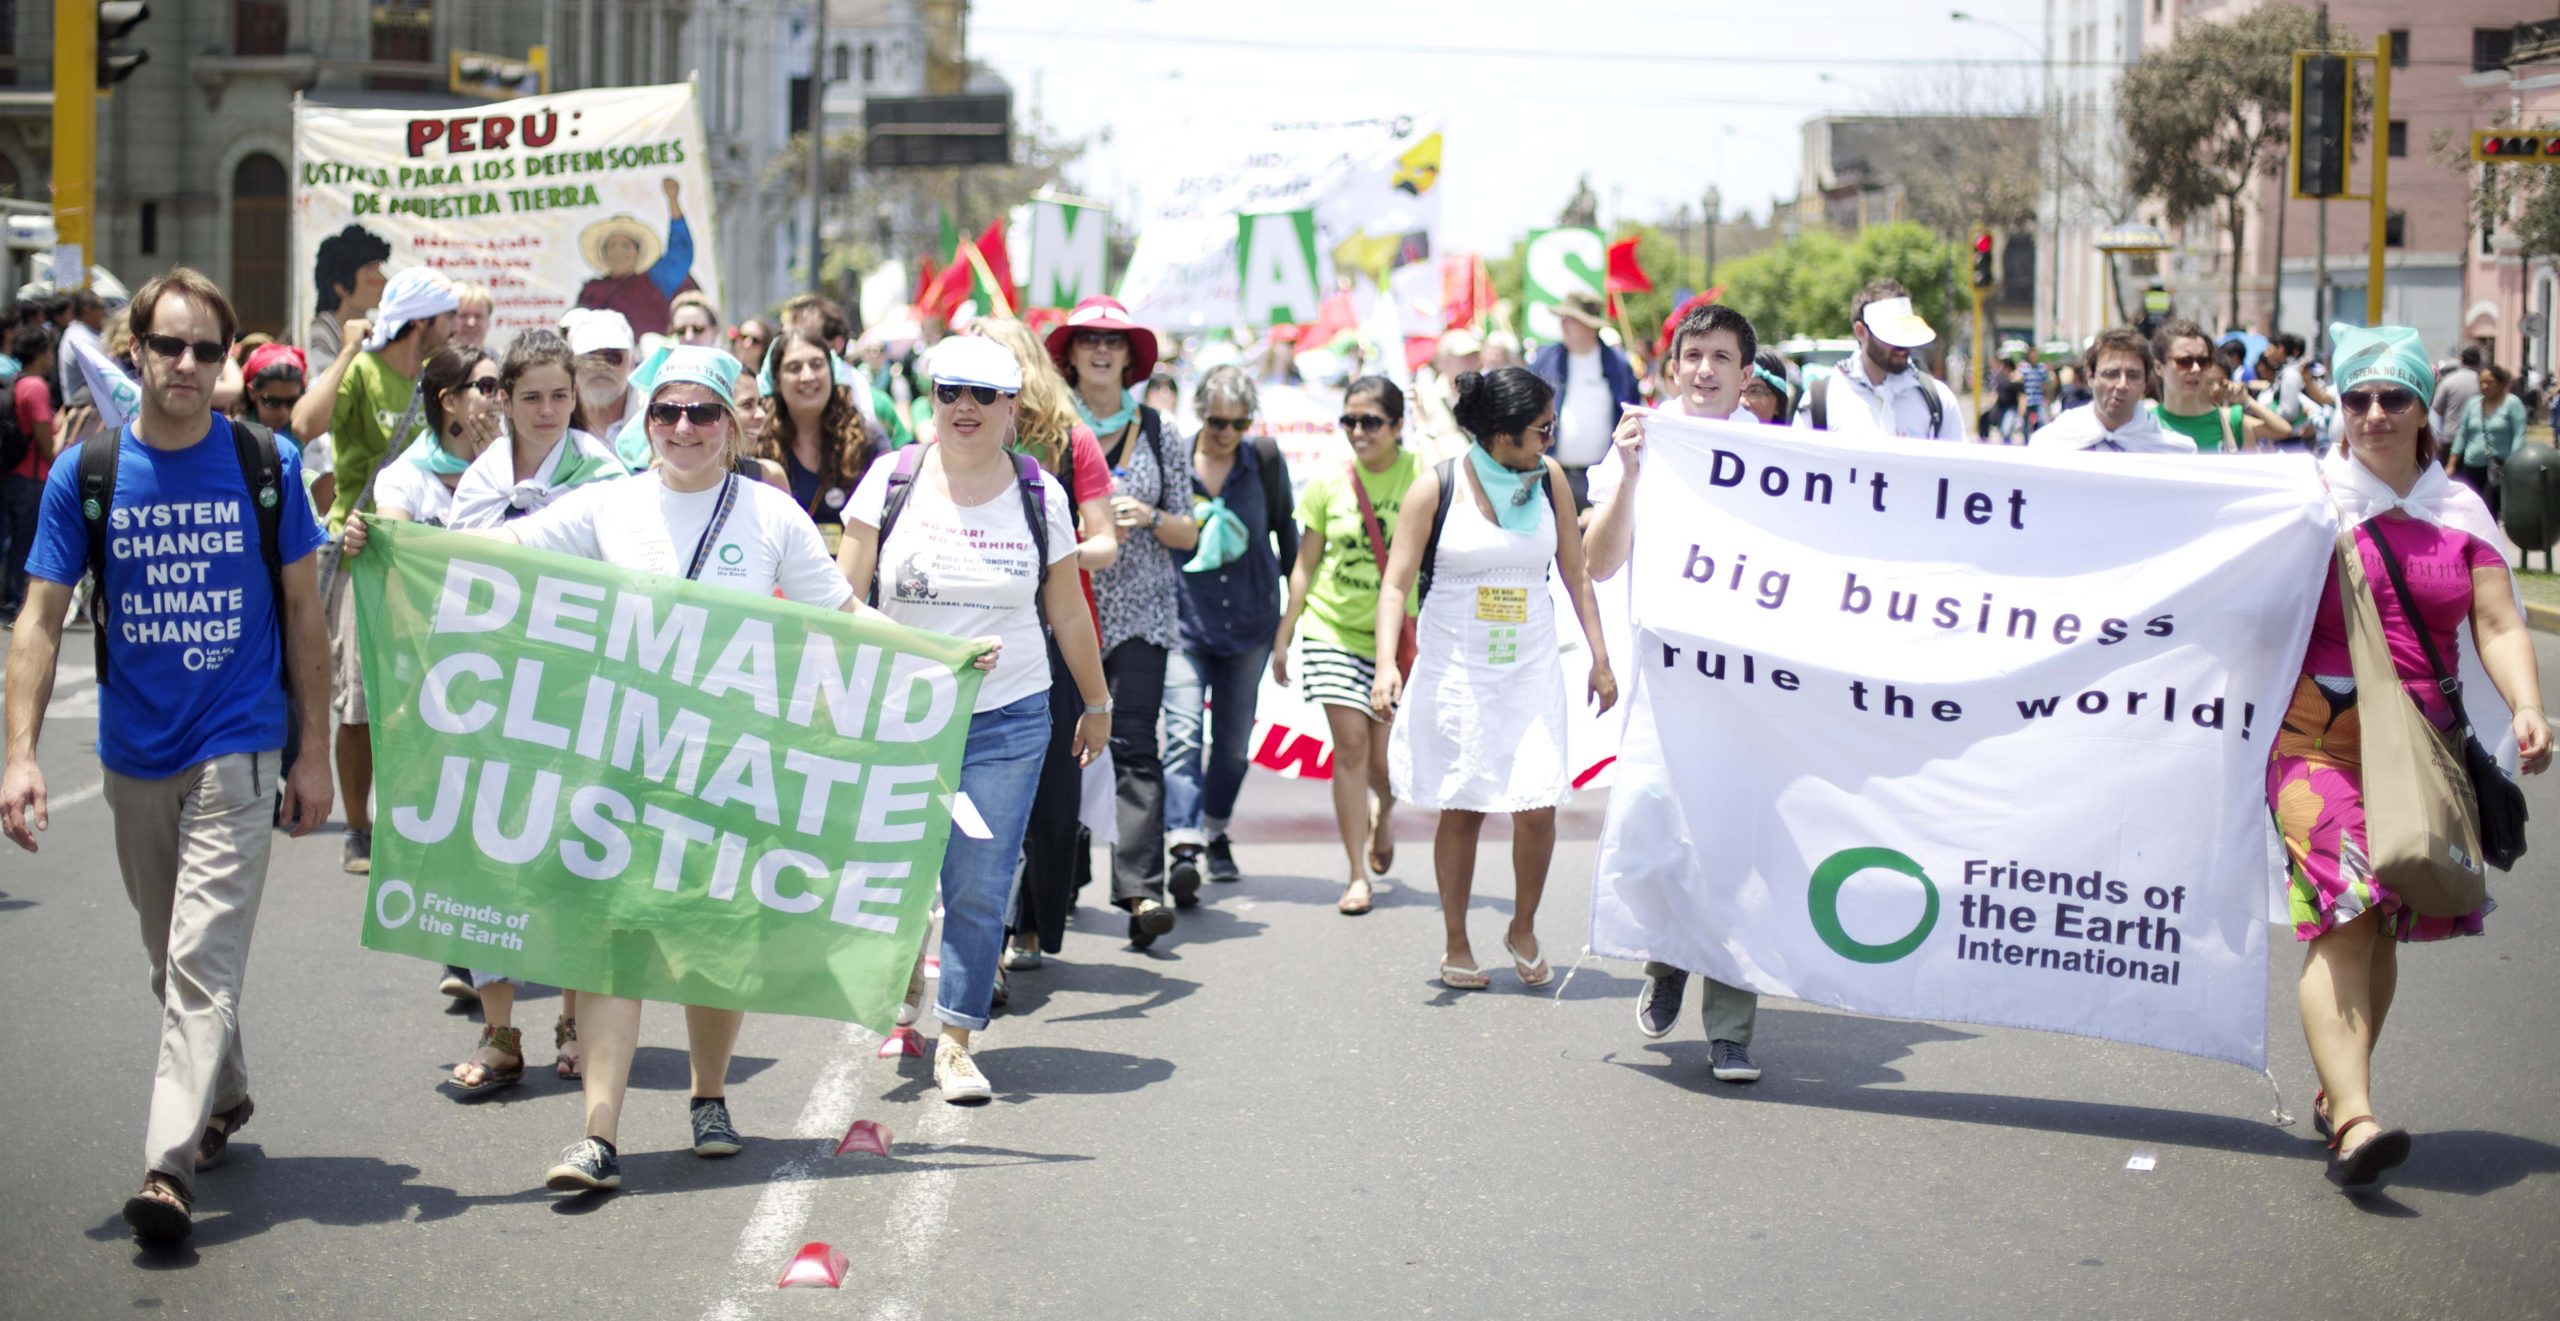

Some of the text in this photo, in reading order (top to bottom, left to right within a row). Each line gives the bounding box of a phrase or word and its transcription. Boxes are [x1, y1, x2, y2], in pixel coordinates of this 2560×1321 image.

[407, 107, 581, 158] PERÚ:
[399, 163, 463, 188] PARA
[473, 158, 515, 181] LOS
[525, 140, 685, 177] DEFENSORES
[353, 192, 381, 216] DE
[508, 184, 600, 212] TIERRA
[1709, 449, 2027, 530] Don't let
[111, 501, 240, 530] SYSTEM
[920, 520, 985, 538] NO WAR!
[112, 530, 244, 559] CHANGE
[146, 562, 211, 585] NOT
[1681, 543, 2176, 646] big business
[121, 588, 243, 615] CLIMATE
[122, 617, 241, 643] CHANGE
[433, 558, 958, 743] DEMAND
[1662, 641, 2257, 740] rule the world!
[418, 652, 939, 843] CLIMATE
[391, 755, 913, 934] JUSTICE
[422, 892, 530, 930] Friends of
[1963, 859, 2187, 914] Friends of
[418, 914, 523, 951] the Earth
[1959, 894, 2182, 954] the Earth
[1957, 934, 2180, 987] International
